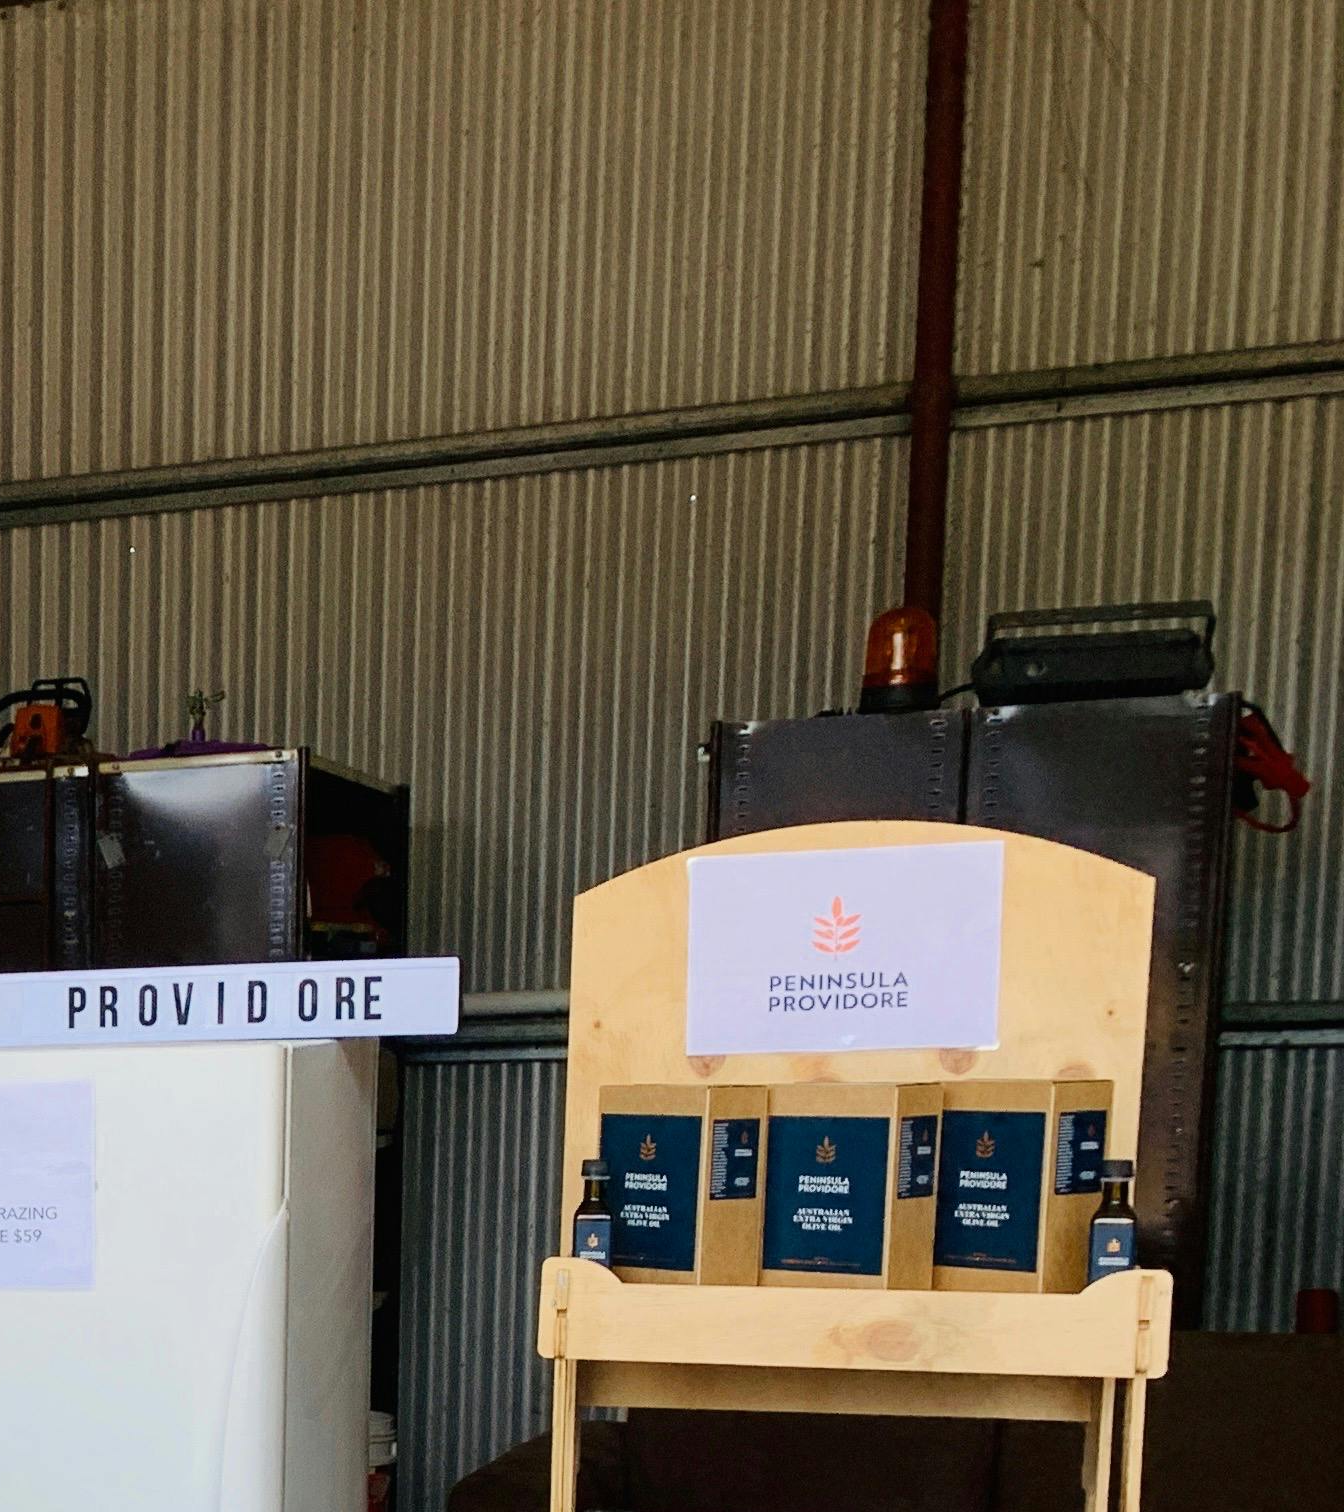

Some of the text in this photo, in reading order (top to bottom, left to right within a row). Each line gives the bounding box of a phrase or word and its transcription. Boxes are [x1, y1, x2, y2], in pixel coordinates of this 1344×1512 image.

[769, 971, 909, 993] PENINSULA
[67, 975, 384, 1030] PROVIDORE
[768, 991, 909, 1013] PROVIDORE
[799, 1175, 849, 1185] PENINSULA
[960, 1170, 1007, 1180] PENINSULA
[798, 1184, 849, 1194] PROVIDORE
[959, 1179, 1007, 1189] PROVIDORE
[13, 1228, 42, 1243] $59
